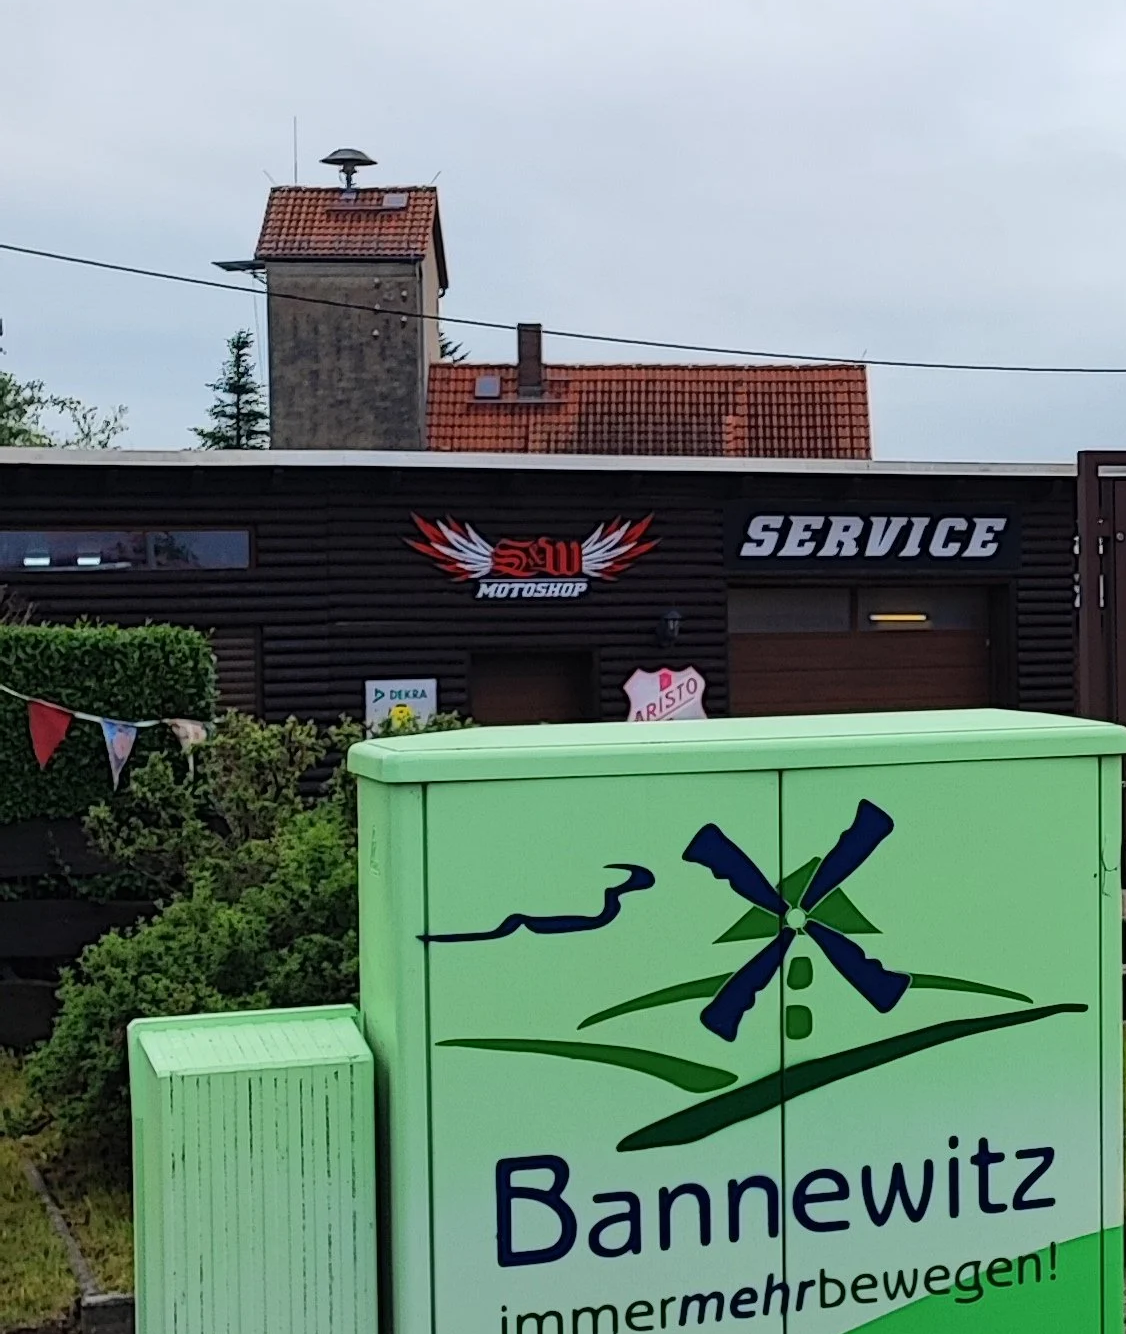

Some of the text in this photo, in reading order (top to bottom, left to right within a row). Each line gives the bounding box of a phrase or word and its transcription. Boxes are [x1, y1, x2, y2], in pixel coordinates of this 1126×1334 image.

[740, 515, 1008, 558] SERVICE
[475, 581, 588, 599] MOTOSHOP
[389, 689, 428, 701] DEKRA
[634, 677, 698, 722] ARISTO
[495, 1134, 1057, 1269] Bannewitz
